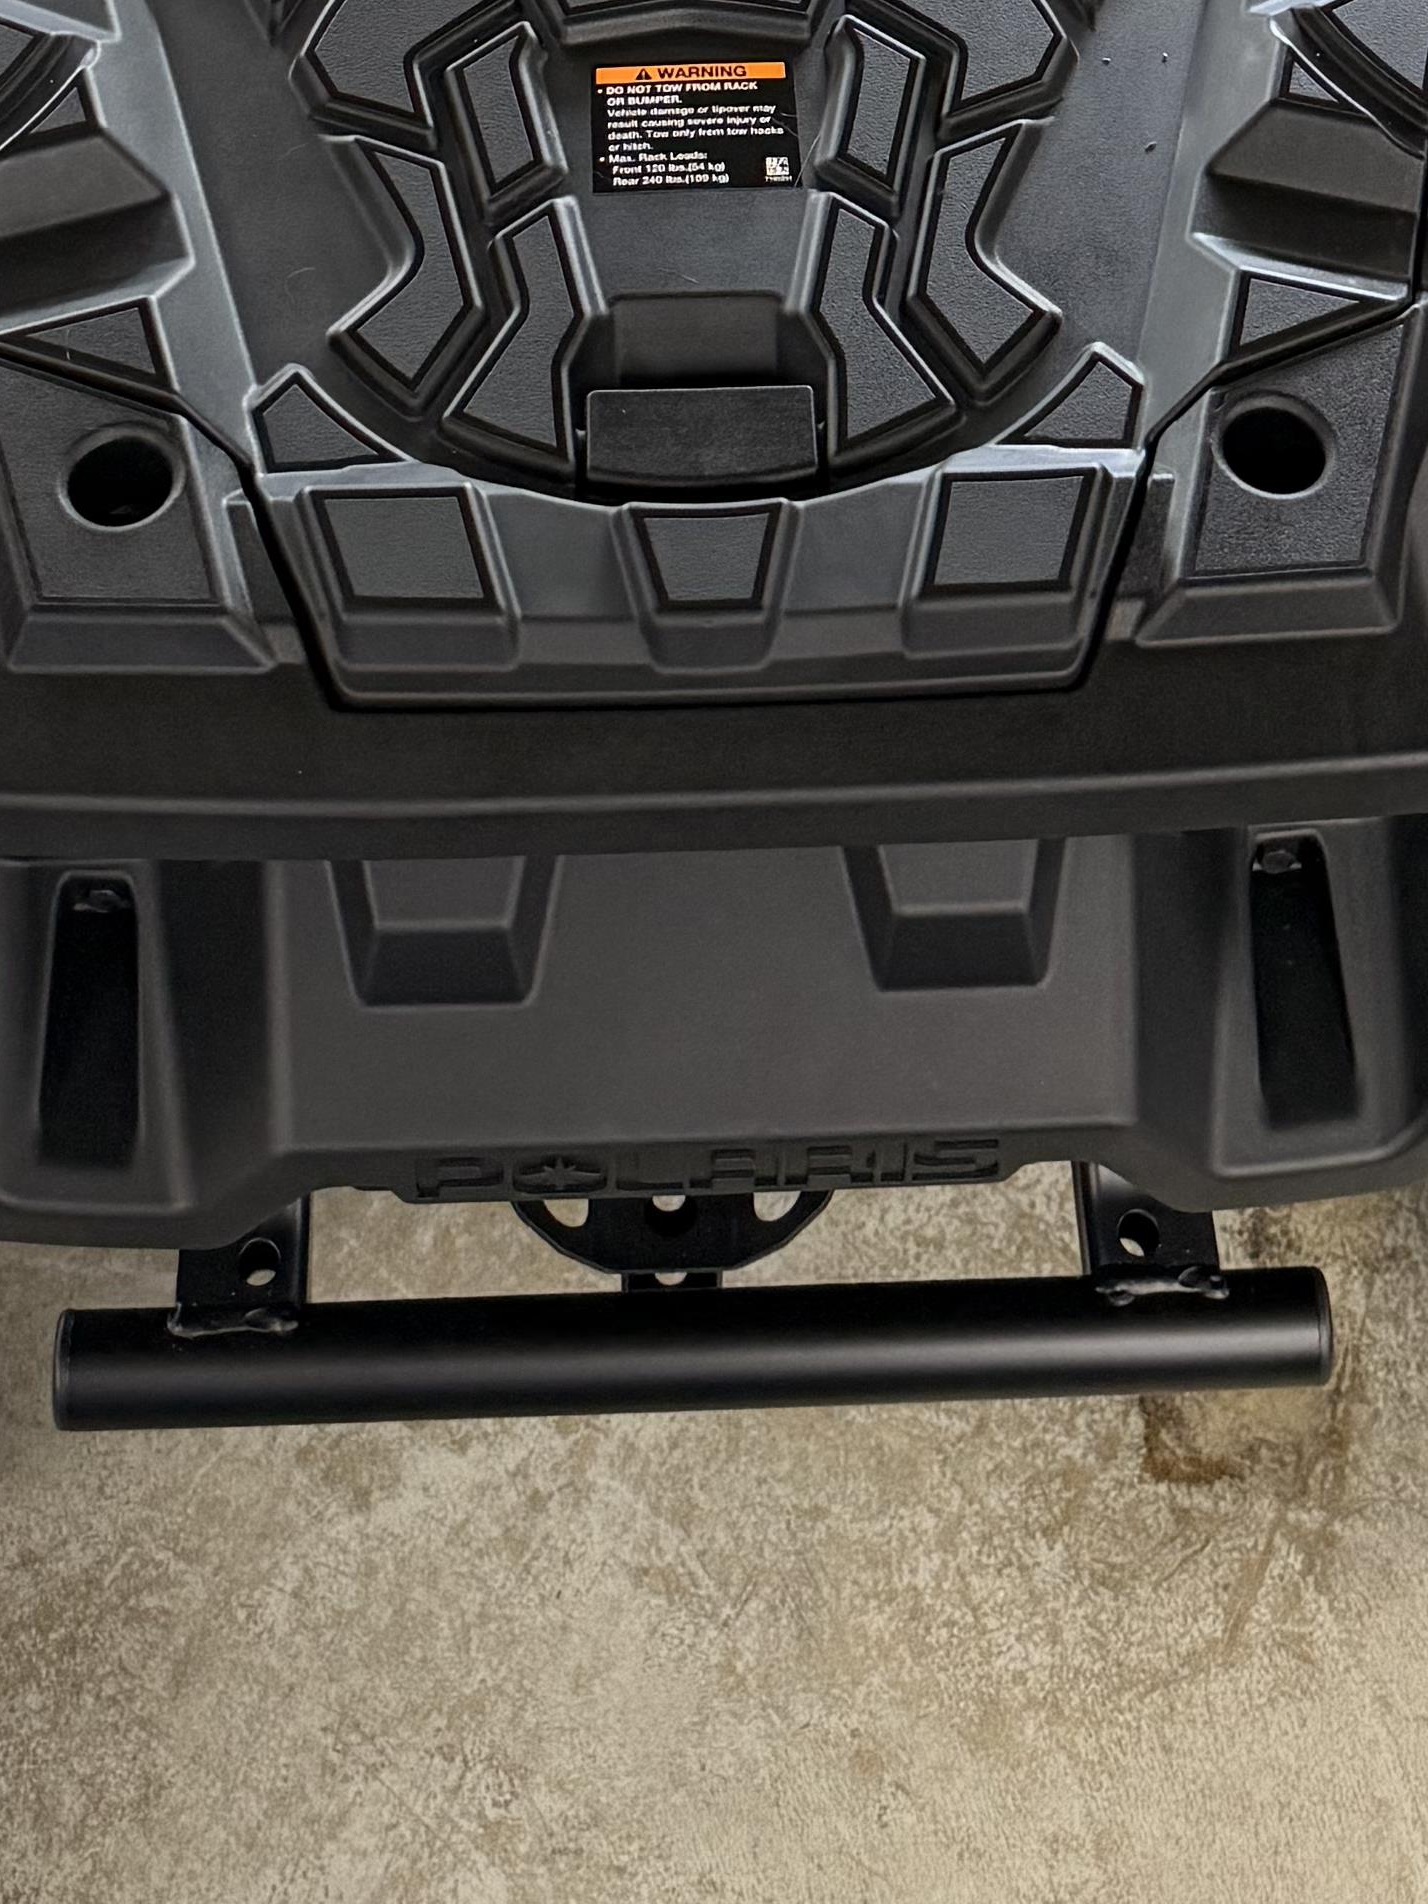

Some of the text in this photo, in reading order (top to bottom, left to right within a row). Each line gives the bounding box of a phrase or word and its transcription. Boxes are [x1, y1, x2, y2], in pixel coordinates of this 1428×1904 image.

[657, 65, 747, 79] WARNING
[606, 81, 758, 95] DO NOT TOW FROM RACK
[607, 95, 683, 106] OR BUMPER.
[607, 108, 647, 118] Vehicle
[650, 106, 695, 117] damage
[712, 104, 750, 114] tipover
[752, 105, 776, 114] may
[607, 118, 639, 128] result
[641, 118, 684, 128] causing
[687, 116, 724, 125] severe
[726, 115, 757, 125] injury
[608, 126, 784, 140] death. Tow only from tow hooks
[608, 141, 654, 152] or hitch.
[609, 151, 708, 163] Max. Rack Loads:
[612, 165, 642, 174] Front
[645, 164, 666, 173] 120
[613, 177, 639, 186] Rear
[642, 176, 663, 185] 240
[416, 1138, 1001, 1198] POLARIS
